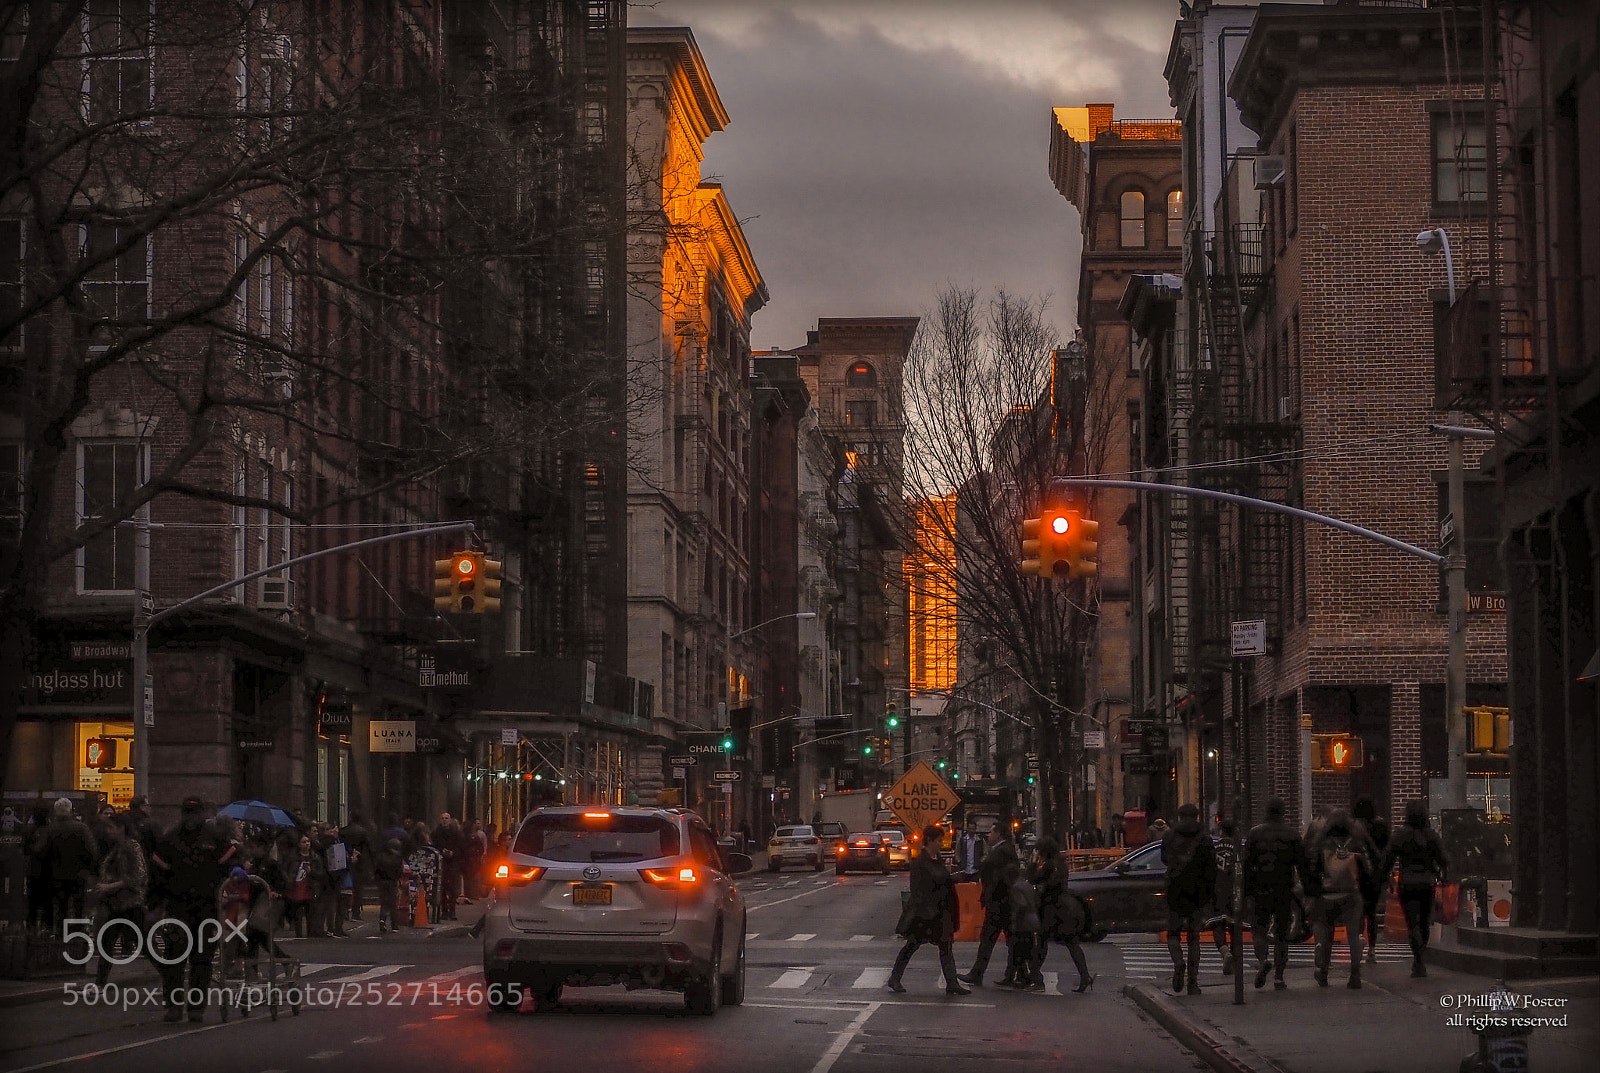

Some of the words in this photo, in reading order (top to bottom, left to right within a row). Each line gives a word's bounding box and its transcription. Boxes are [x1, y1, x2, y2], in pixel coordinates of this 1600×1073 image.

[1470, 596, 1481, 609] W
[73, 646, 81, 657] W
[85, 645, 130, 658] Broadway
[22, 669, 89, 694] nglass
[93, 669, 124, 688] hut
[373, 730, 413, 738] LUANA
[903, 783, 938, 796] LANE
[893, 798, 948, 810] CLOSED
